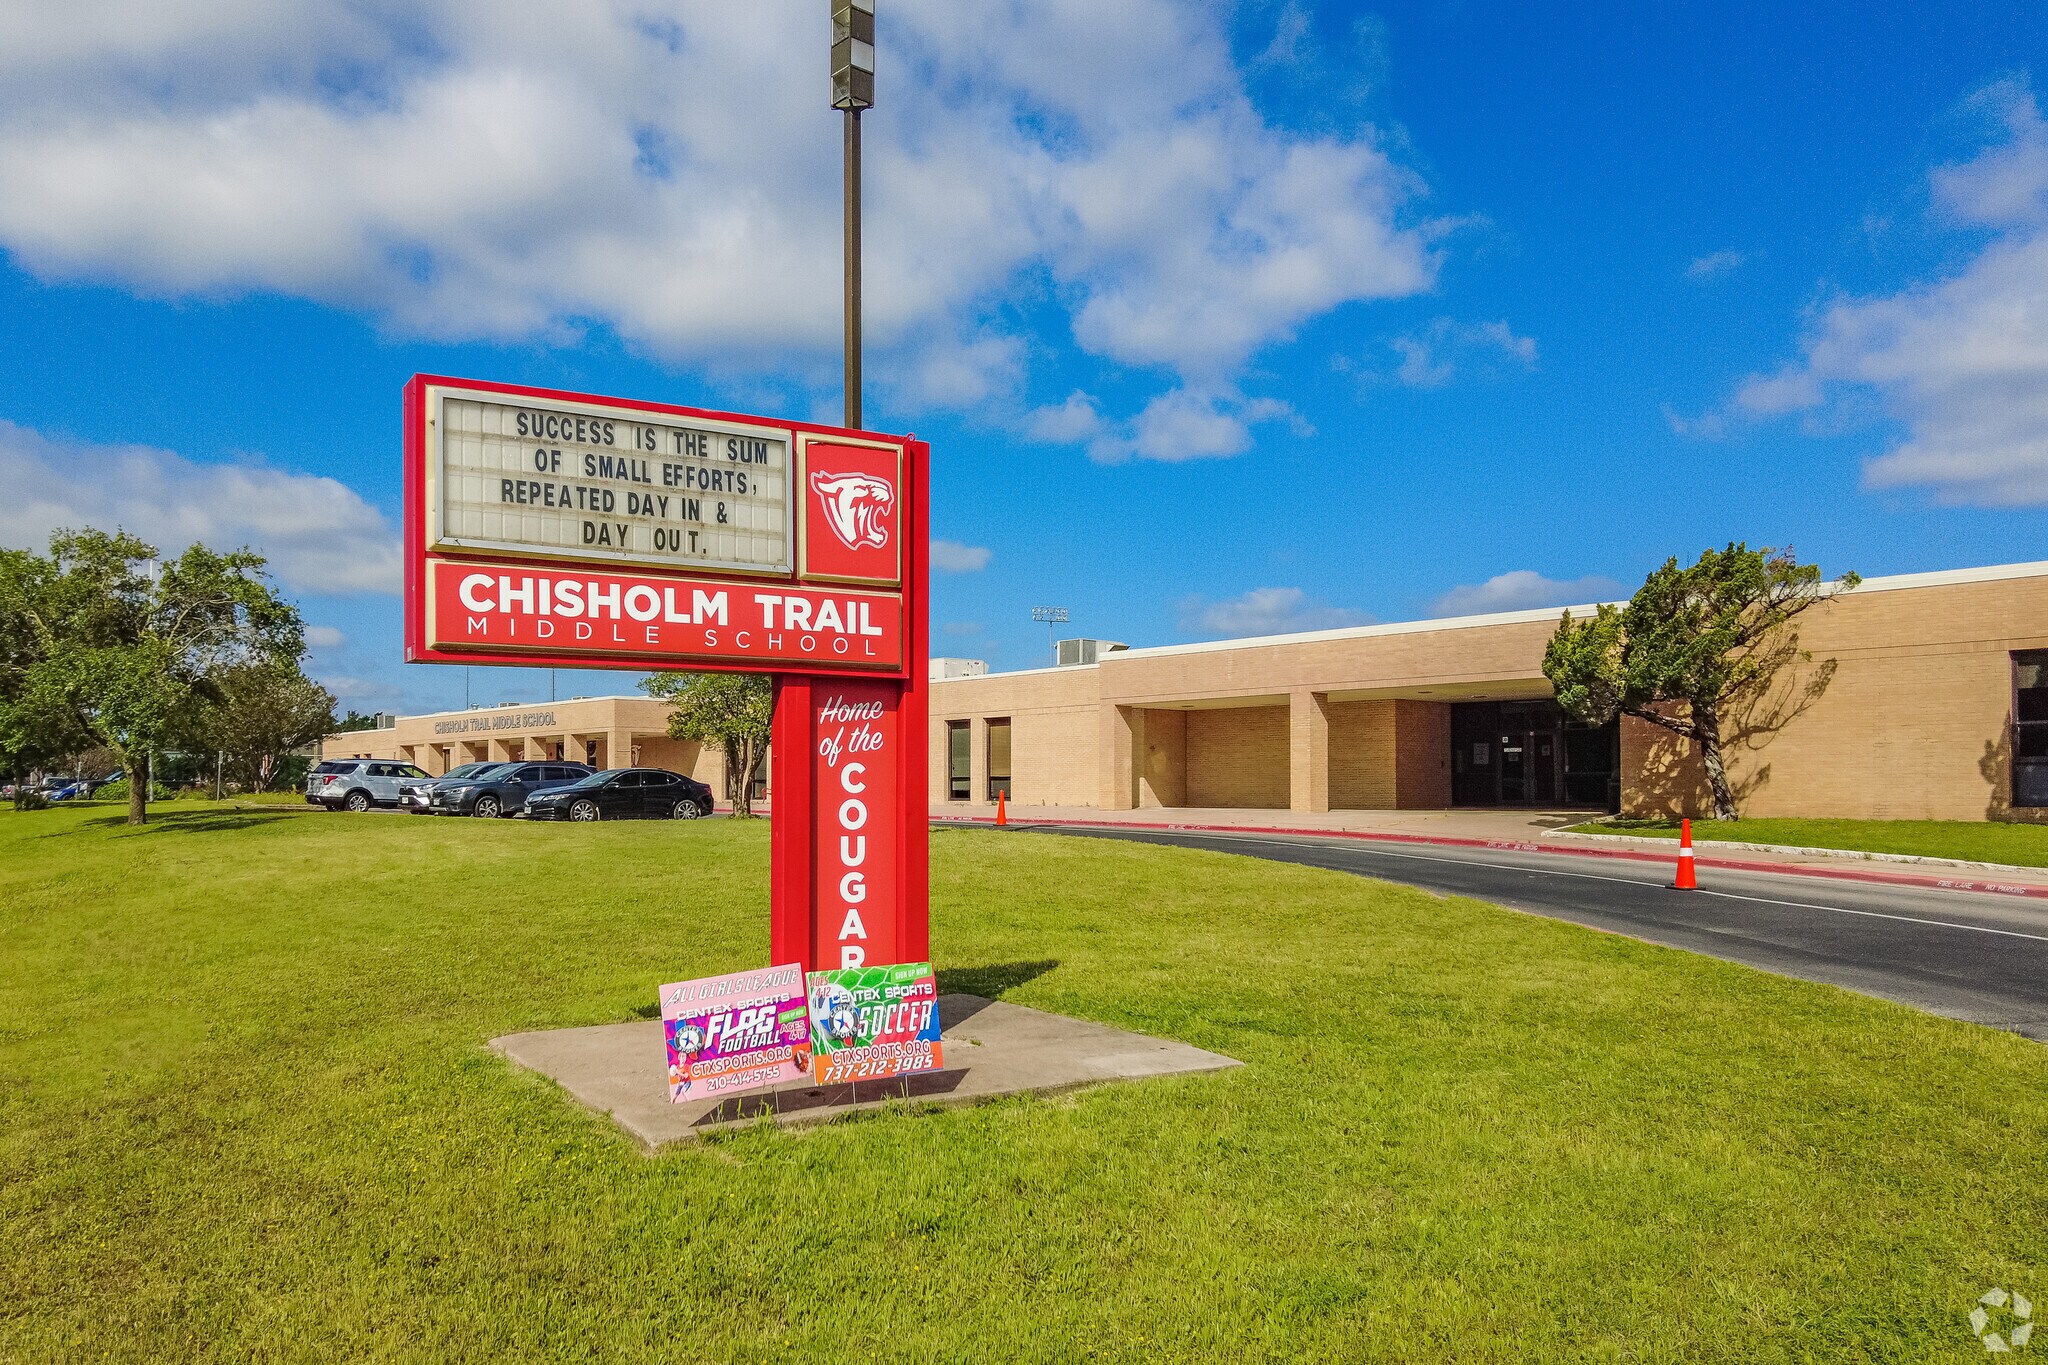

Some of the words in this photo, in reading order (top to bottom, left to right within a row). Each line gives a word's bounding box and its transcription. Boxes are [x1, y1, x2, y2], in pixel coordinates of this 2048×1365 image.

[517, 412, 614, 445] SUCCESS
[636, 428, 656, 450] IS
[674, 431, 708, 458] THE
[727, 441, 768, 465] SUM
[535, 449, 561, 473] OF
[585, 454, 651, 484] SMALL
[663, 464, 757, 496] EFFORTS,
[502, 479, 615, 513] REPEATED
[628, 492, 672, 518] DAY
[681, 498, 700, 521] IN
[716, 503, 728, 524] &
[583, 521, 628, 547] DAY
[654, 528, 707, 555] OUT.
[459, 573, 728, 626] CHISHOLM
[755, 595, 882, 636] TRAIL
[468, 617, 660, 644] MIDDLE
[705, 629, 876, 656] SCHOOL
[435, 719, 468, 734] CHISHOLM
[470, 717, 491, 731] TRAIL
[492, 715, 521, 730] MIDDLE
[522, 712, 557, 727] SCHOOL
[819, 694, 884, 725] Home
[819, 726, 843, 768] of
[849, 722, 884, 753] the
[1936, 880, 1953, 888] FIRE
[1954, 882, 1973, 890] LANE
[1998, 885, 2026, 894] PARKING
[664, 987, 695, 1008] ALL
[699, 979, 744, 1000] GIRLS
[745, 968, 799, 993] LEAGUE
[810, 976, 828, 986] AGES
[895, 970, 907, 979] SIGN
[908, 969, 915, 977] UP
[916, 967, 928, 976] NOW
[676, 1003, 733, 1020] CENTEX
[737, 993, 790, 1010] SPORTS
[832, 988, 880, 1004] CENTEX
[885, 984, 933, 999] SPORTS
[704, 1005, 777, 1050] FLAG
[781, 1020, 805, 1033] AGES
[857, 1000, 933, 1037] SOCCER
[718, 1030, 780, 1054] FOOTBALL
[831, 1039, 931, 1065] CTXSPORTS.ORG
[691, 1045, 792, 1077] CTXSPORTS.ORG
[824, 1054, 934, 1081] 737-212-3985
[707, 1066, 780, 1090] 210-414-5755
